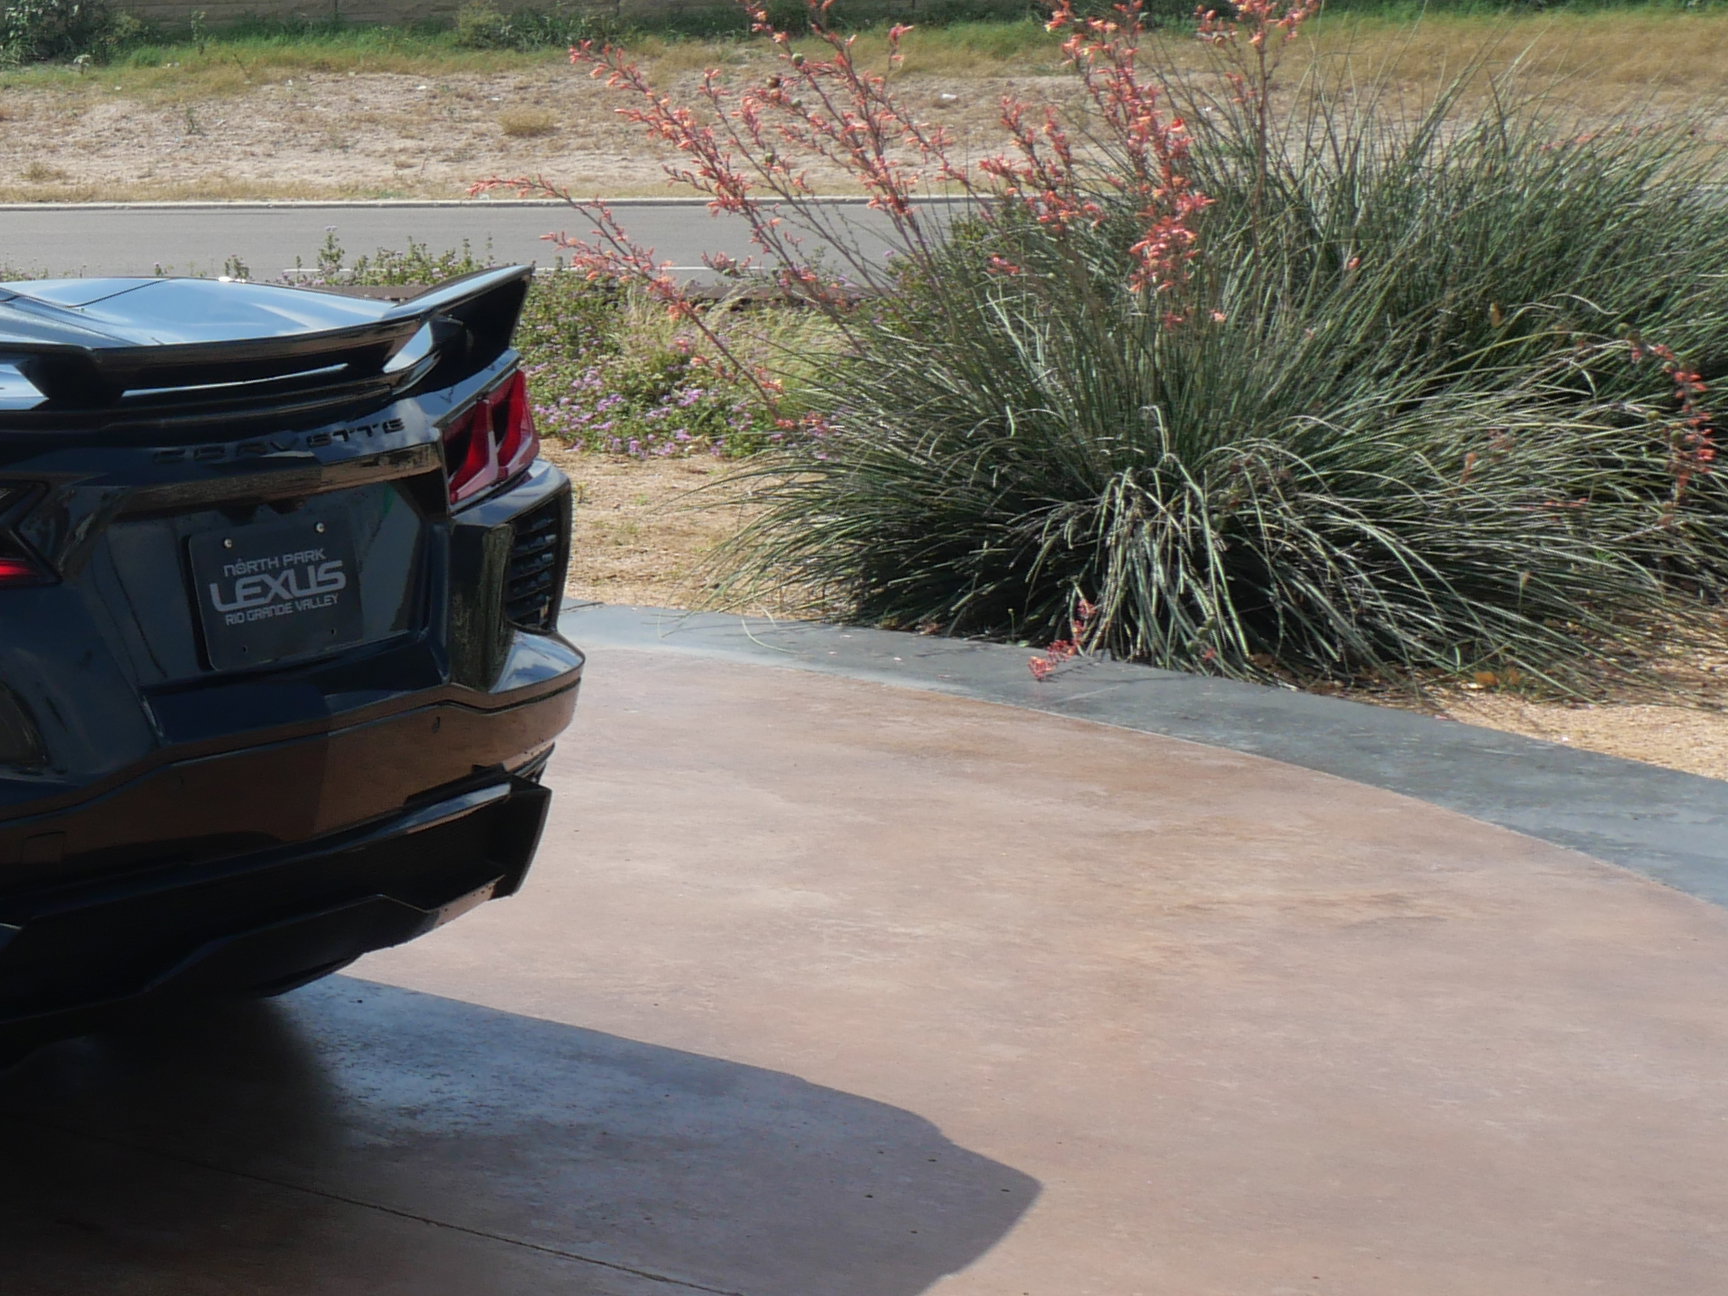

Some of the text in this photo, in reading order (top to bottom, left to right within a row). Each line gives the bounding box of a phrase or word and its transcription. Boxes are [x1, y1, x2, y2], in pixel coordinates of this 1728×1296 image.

[282, 548, 327, 566] PARK
[209, 560, 347, 613] LEXUS
[225, 593, 339, 626] RIO GRANDE VALLEY
